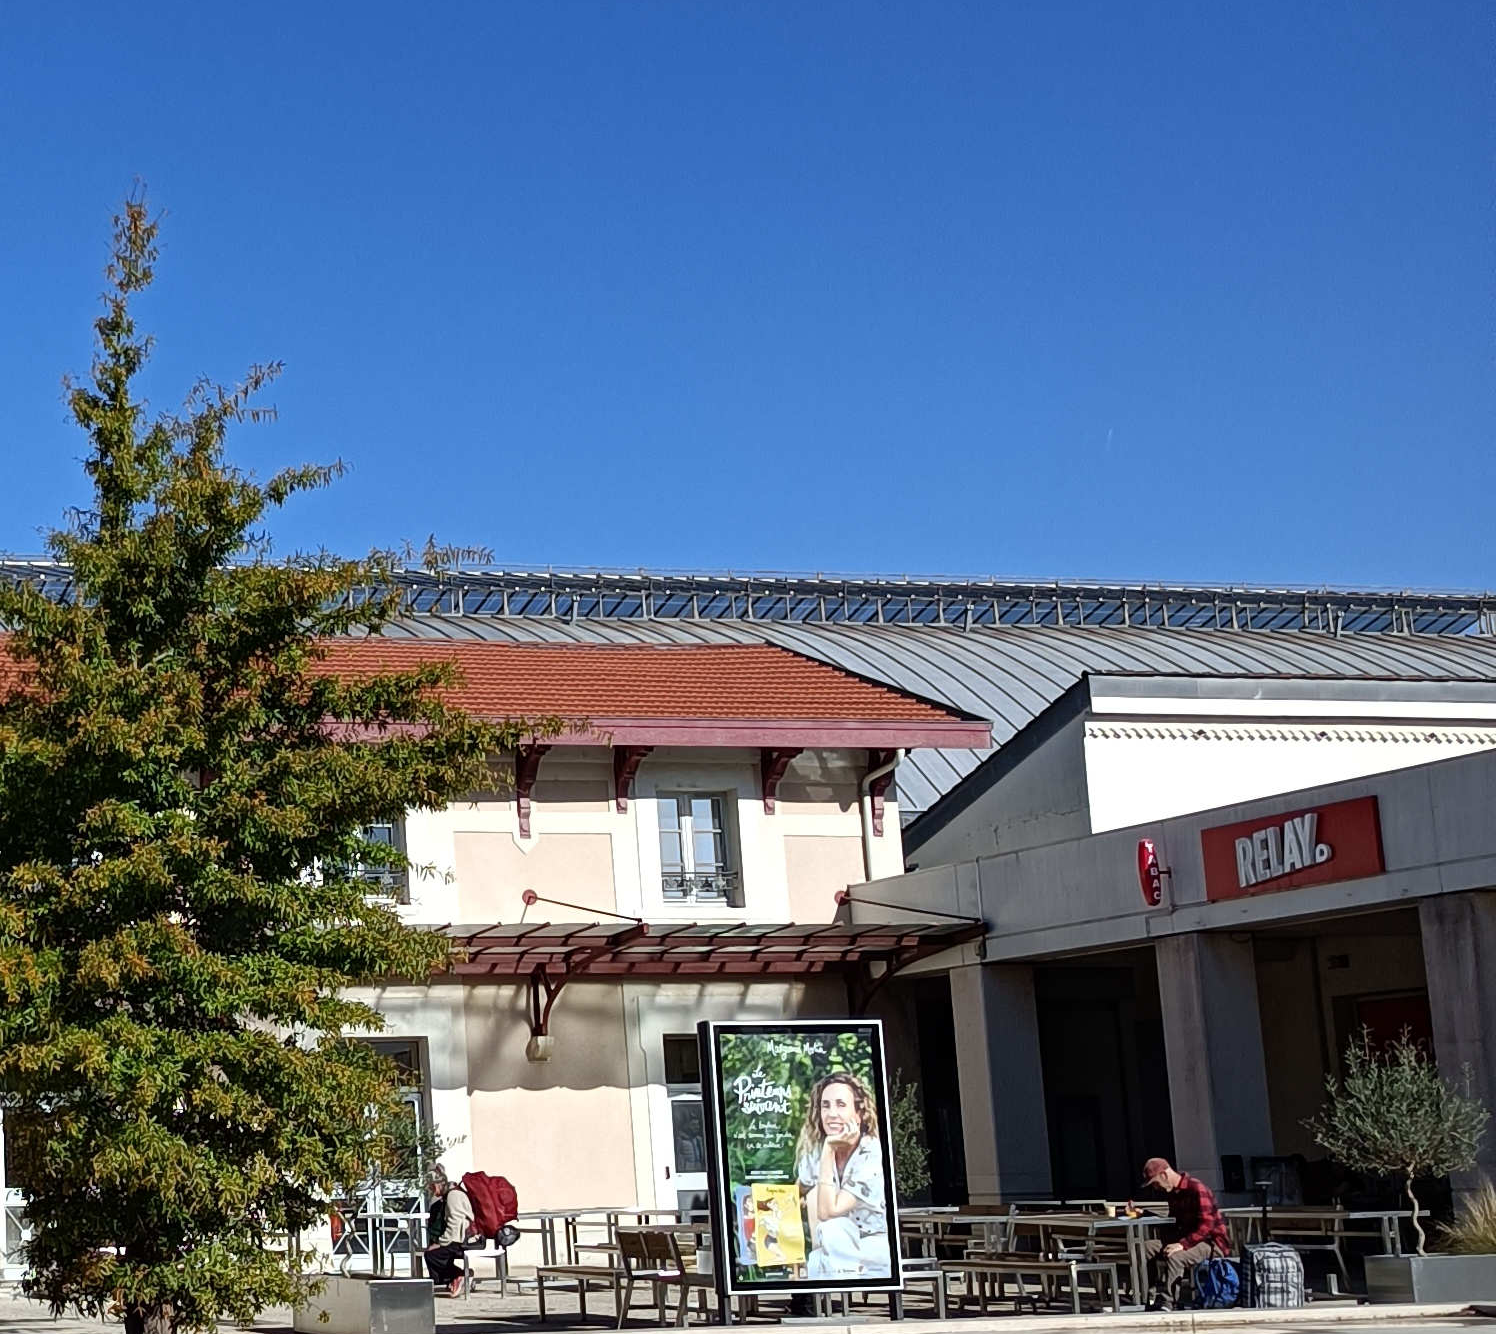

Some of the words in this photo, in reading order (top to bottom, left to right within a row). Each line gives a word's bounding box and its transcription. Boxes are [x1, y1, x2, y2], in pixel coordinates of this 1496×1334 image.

[1144, 840, 1161, 900] TABAC
[733, 1075, 792, 1104] Printemps
[741, 1098, 792, 1115] suivant
